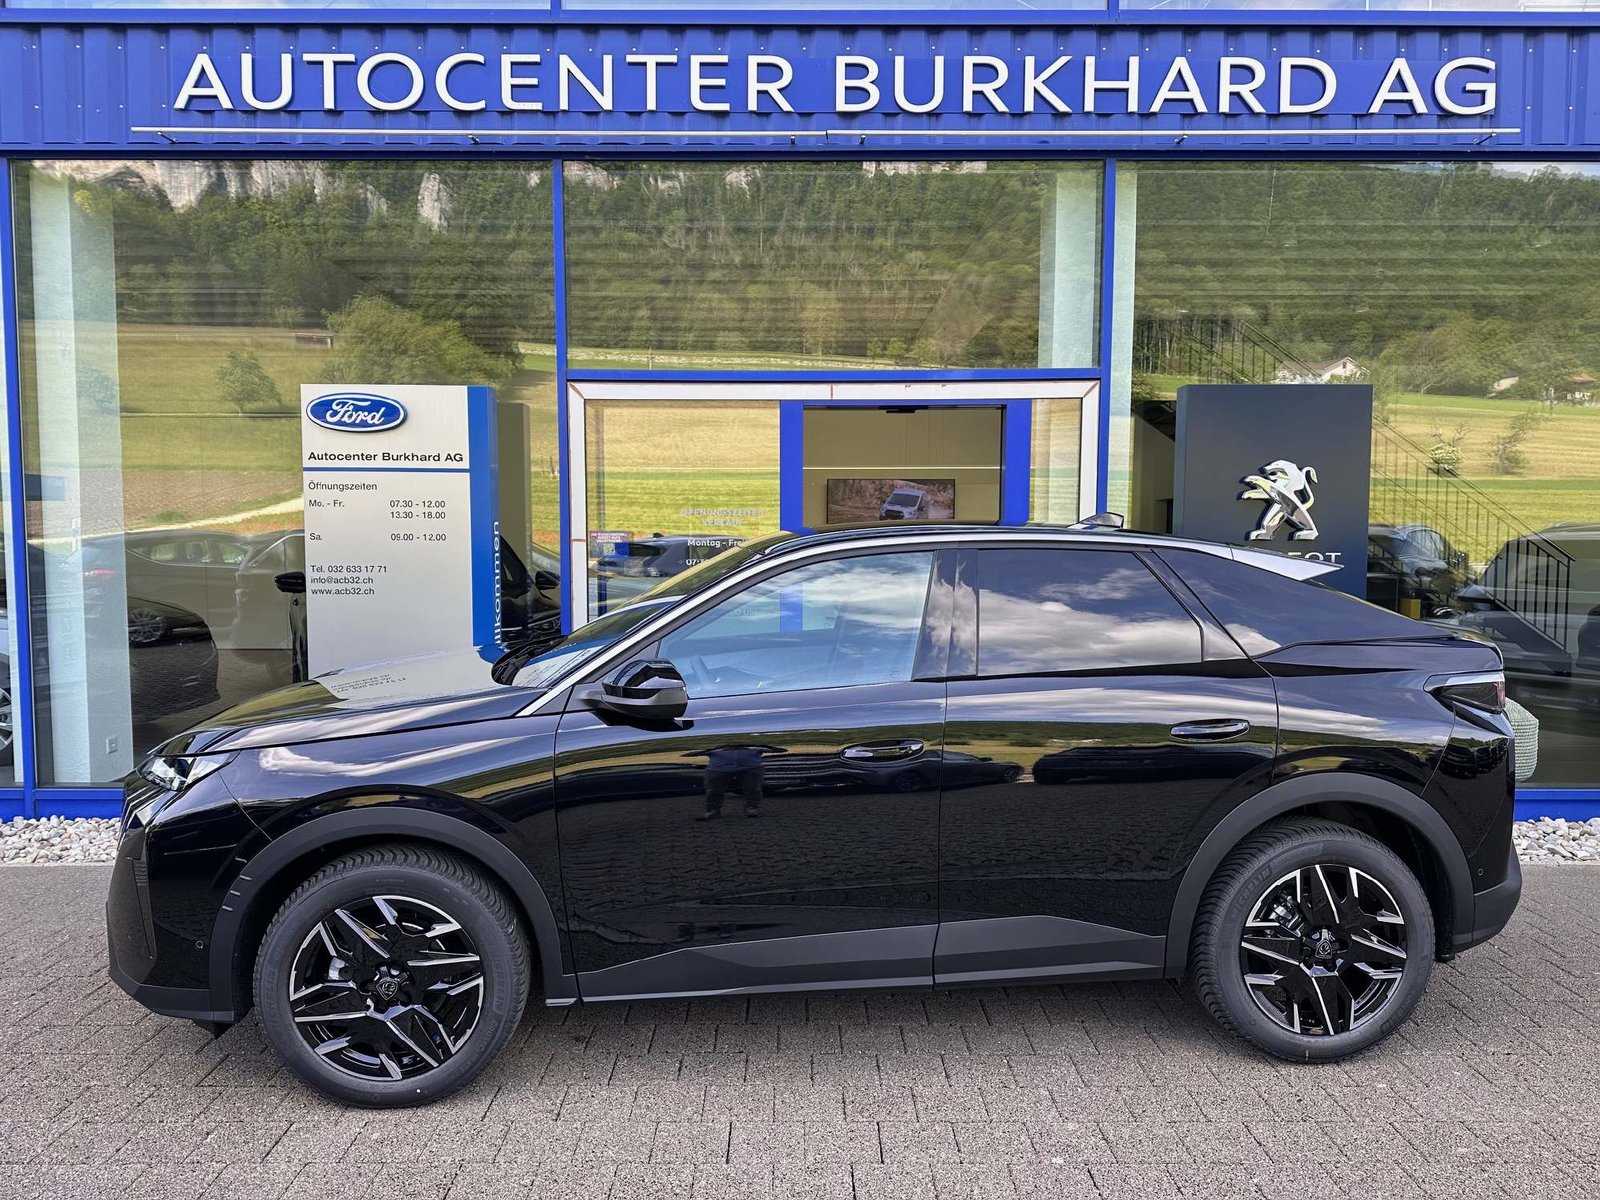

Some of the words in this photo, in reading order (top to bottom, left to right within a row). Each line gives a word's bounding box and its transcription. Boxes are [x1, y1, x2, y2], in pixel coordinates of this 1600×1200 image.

[173, 53, 794, 112] AUTOCENTER
[834, 55, 1338, 115] BURKHARD
[1368, 57, 1497, 116] AG
[325, 399, 386, 425] Ford
[308, 451, 378, 462] Autocenter
[382, 452, 441, 462] Burkhard
[444, 453, 464, 463] AG
[308, 481, 378, 493] Öffnungszeiten
[308, 499, 325, 508] Mo.
[333, 499, 345, 508] Fr.
[389, 500, 413, 508] 07.30
[422, 500, 446, 508] 12.00
[390, 511, 413, 519] 13.30
[422, 511, 446, 519] 18.00
[309, 532, 323, 541] Sa.
[390, 533, 413, 541] 09.00
[423, 533, 447, 541] 12.00
[687, 539, 721, 548] Montag
[310, 565, 325, 573] Tel.
[327, 565, 343, 573] 032
[346, 565, 362, 573] 633
[364, 565, 375, 573] 17
[377, 565, 388, 573] 71
[310, 576, 374, 584] info@acb32.ch
[493, 521, 501, 644] illkommen
[311, 587, 375, 595] www.acb32.ch
